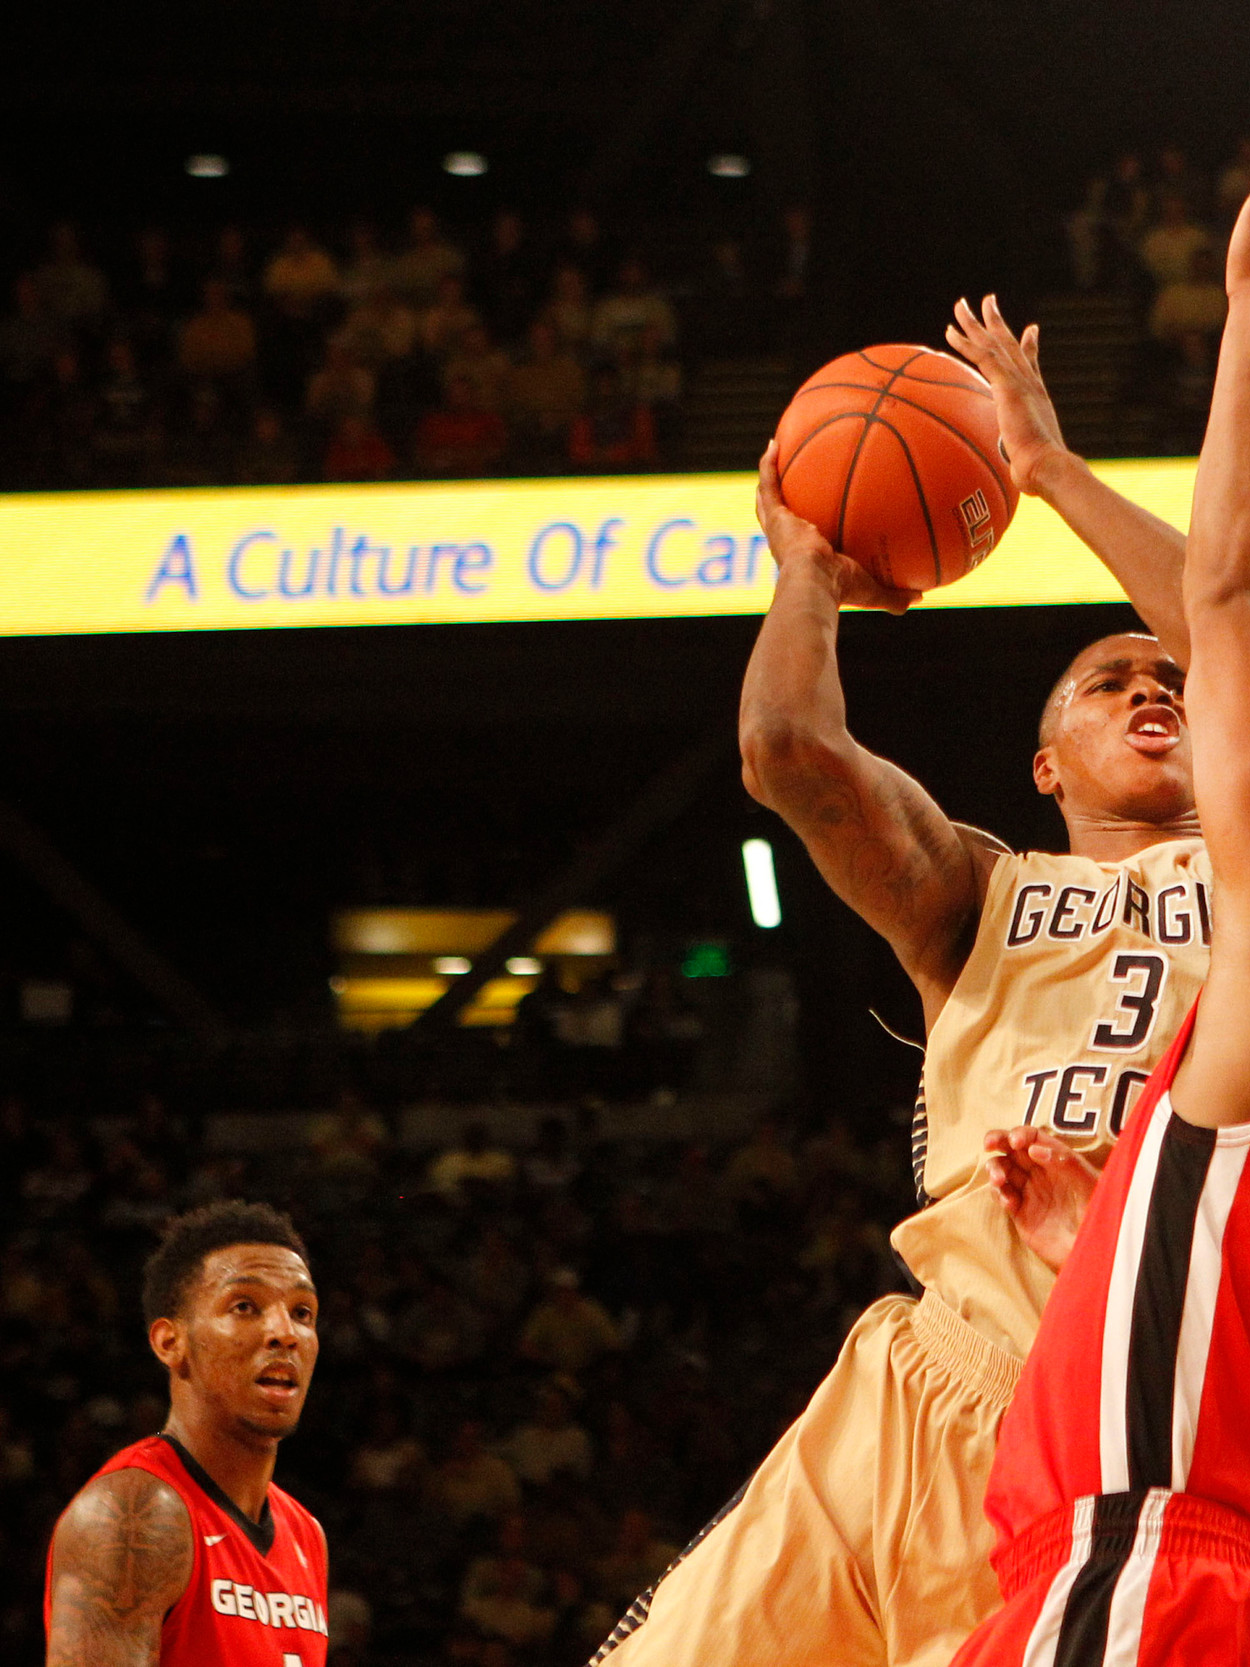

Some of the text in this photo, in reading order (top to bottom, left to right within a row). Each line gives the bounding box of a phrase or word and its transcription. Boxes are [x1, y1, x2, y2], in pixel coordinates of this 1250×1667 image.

[146, 517, 779, 602] A Culture Of Car
[1007, 867, 1212, 949] GEORGI
[1087, 951, 1169, 1054] 3
[1022, 1062, 1153, 1140] TEC
[210, 1578, 328, 1637] GEORGIA
